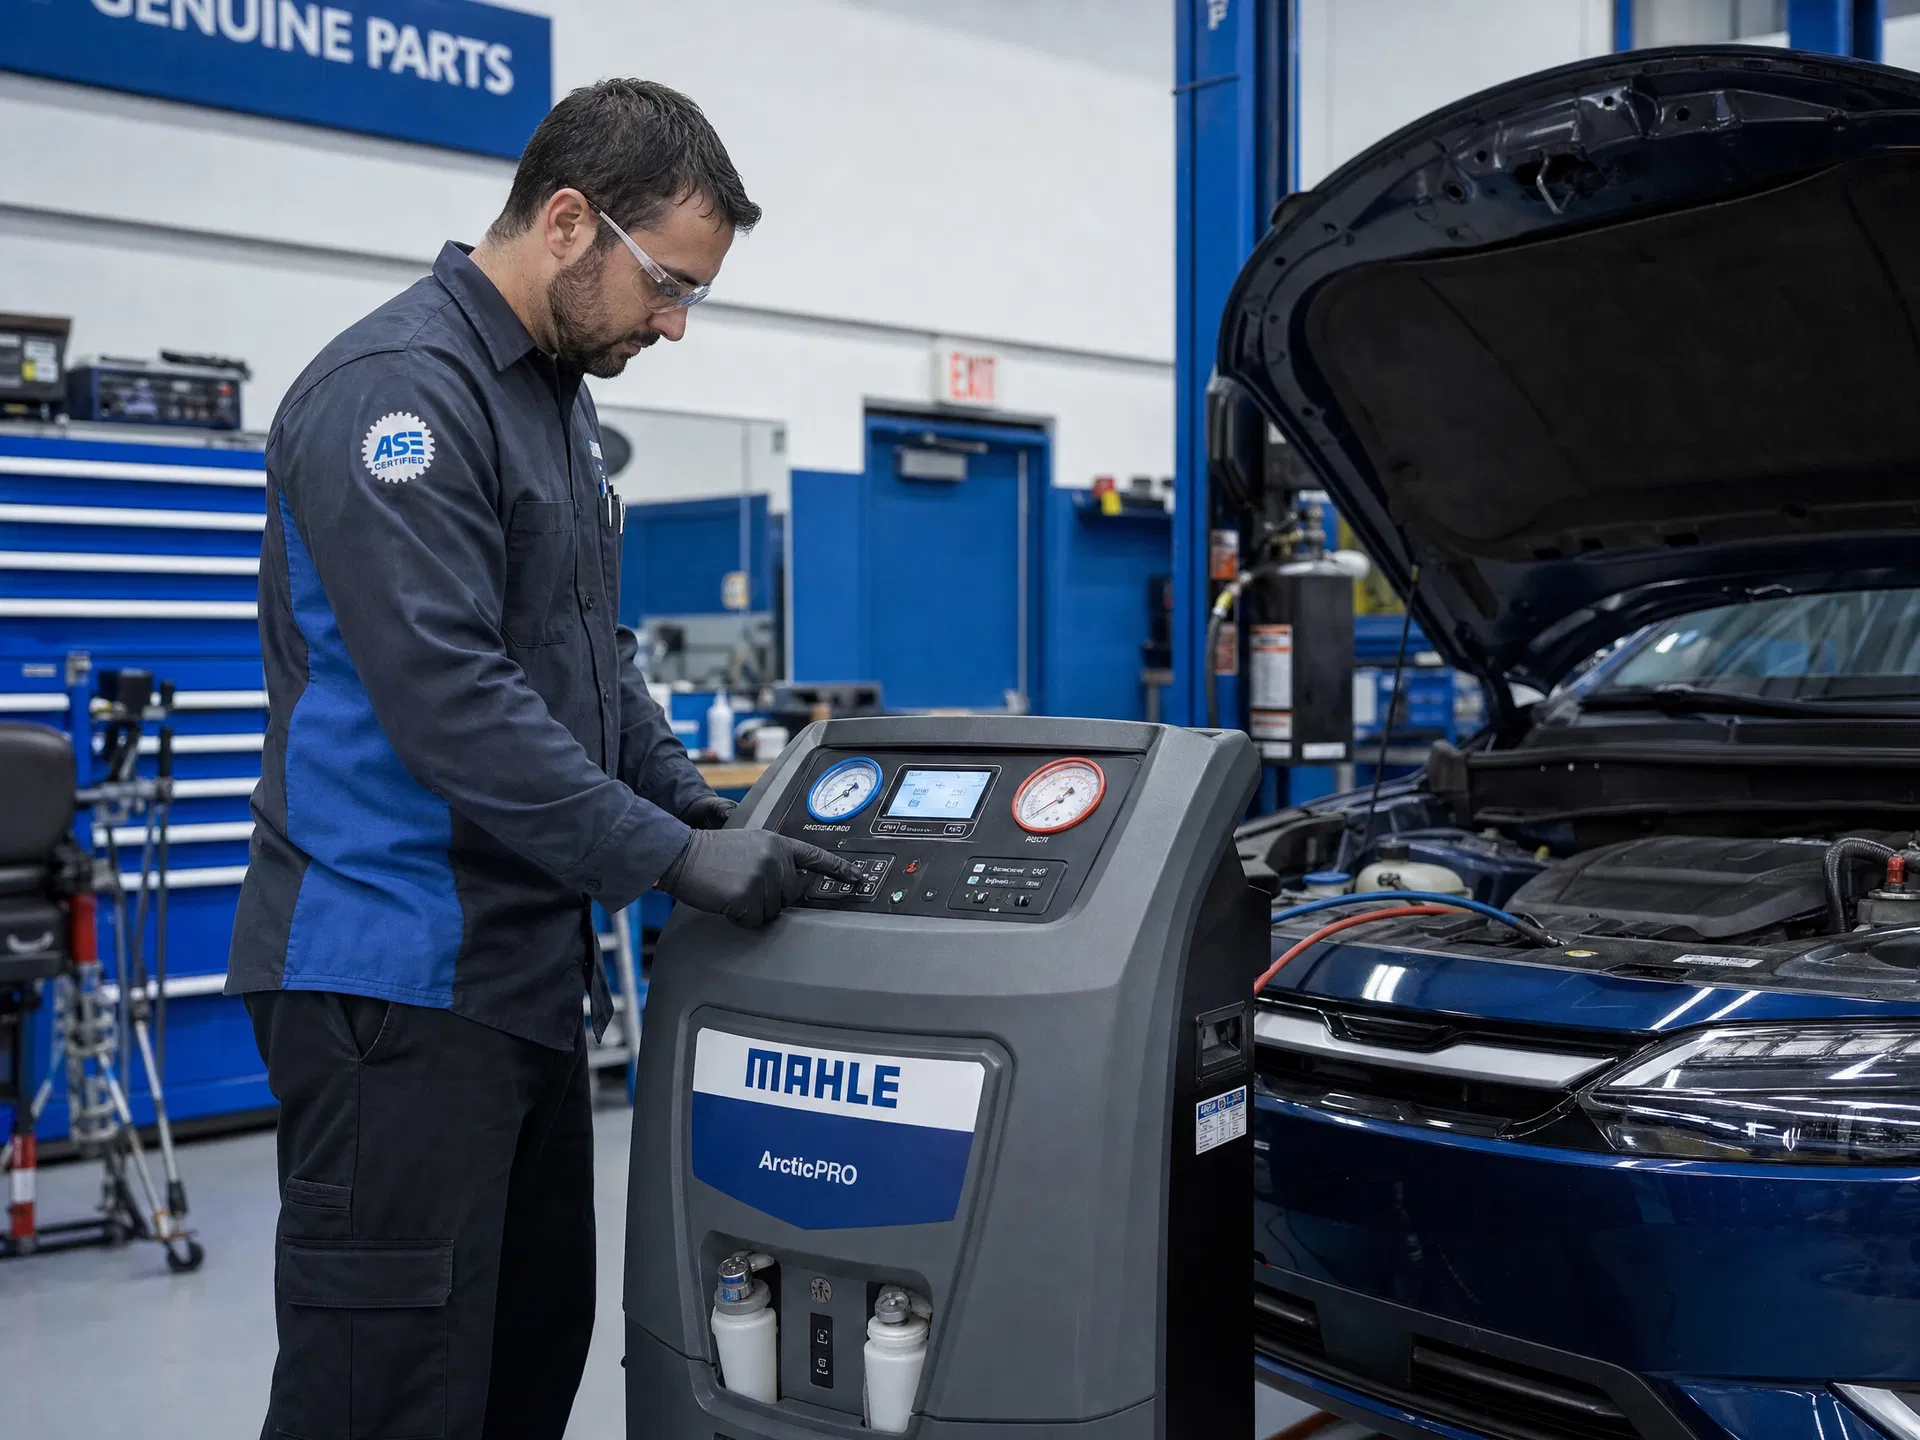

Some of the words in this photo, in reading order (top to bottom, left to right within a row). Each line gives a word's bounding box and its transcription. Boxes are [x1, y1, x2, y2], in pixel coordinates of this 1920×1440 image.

[366, 16, 515, 96] PARTS
[372, 431, 425, 462] ASE
[374, 456, 425, 471] CERTIFIED
[745, 1048, 901, 1109] MAHLE
[758, 1150, 858, 1185] ArcticPRO
